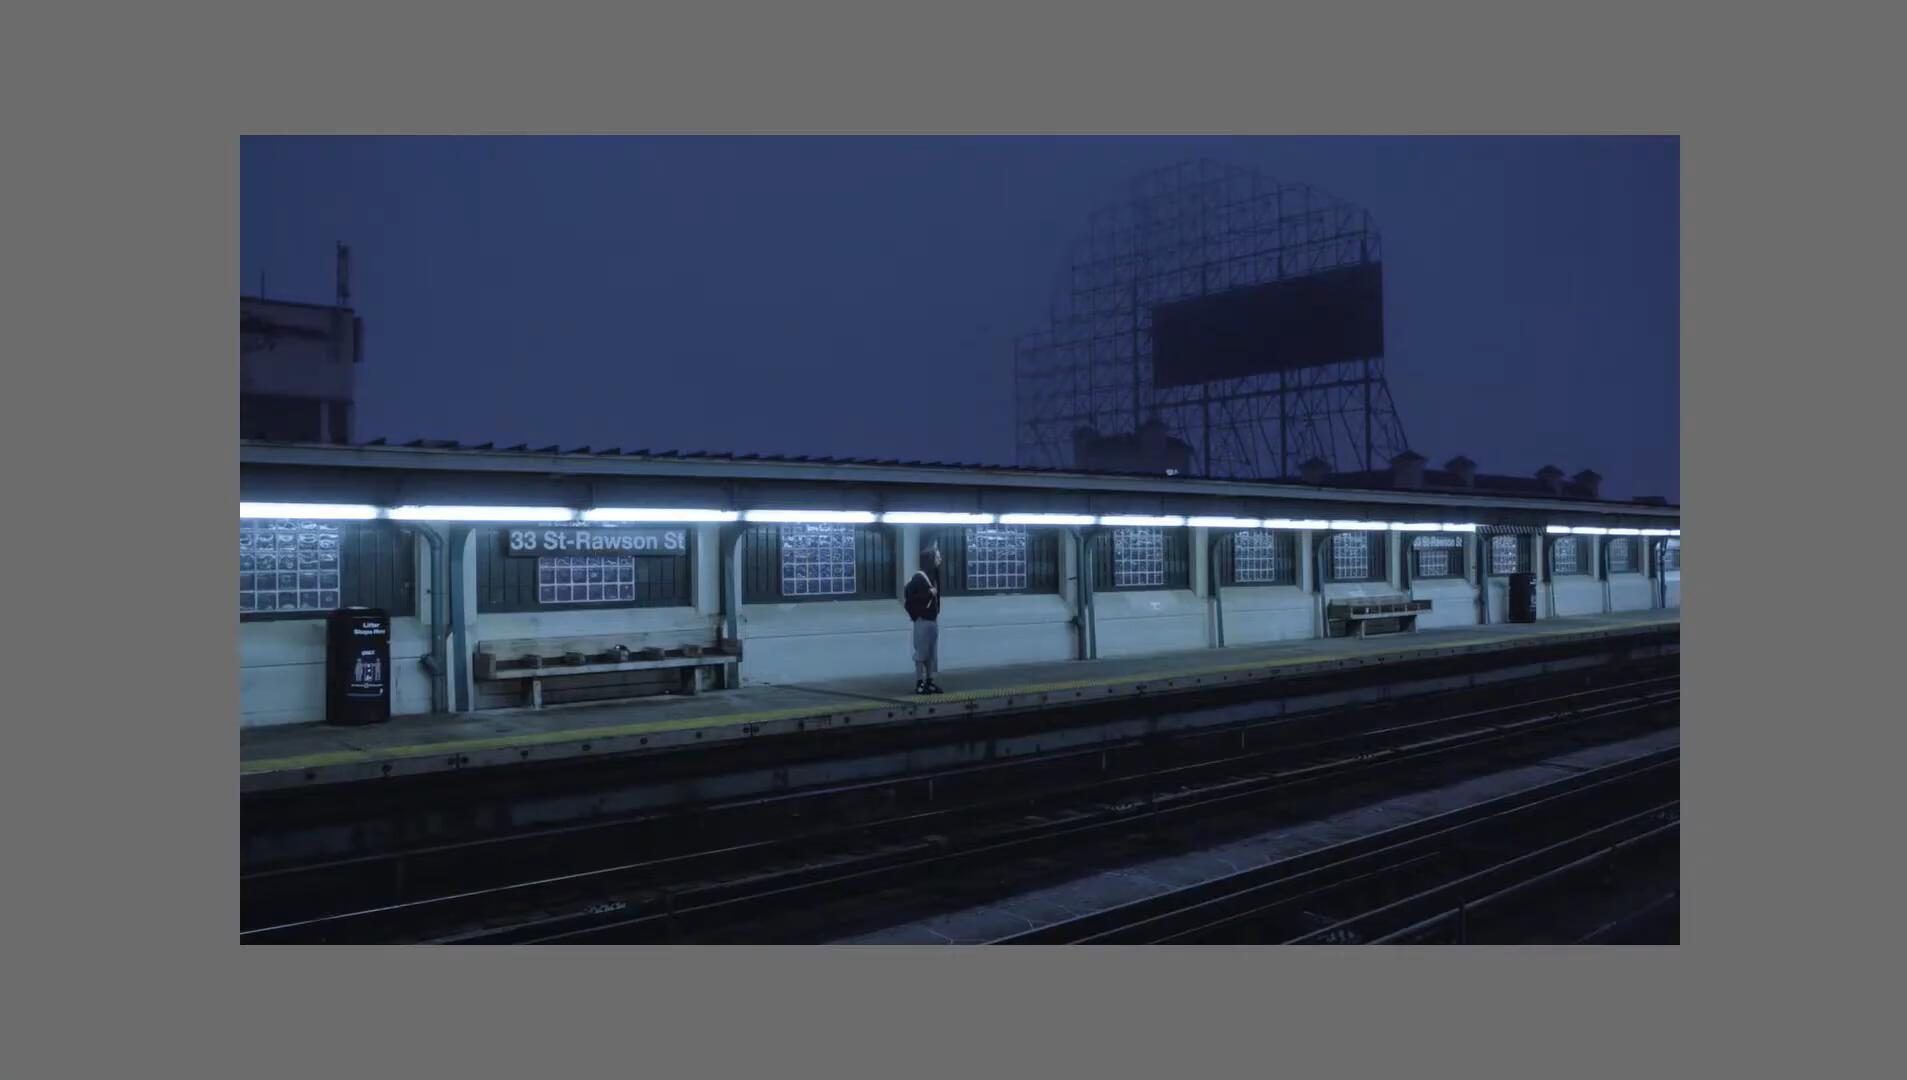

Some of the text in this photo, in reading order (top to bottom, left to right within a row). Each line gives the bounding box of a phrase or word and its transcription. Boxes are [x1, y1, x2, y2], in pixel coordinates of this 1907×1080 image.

[511, 530, 686, 550] 33 St-Rawson St
